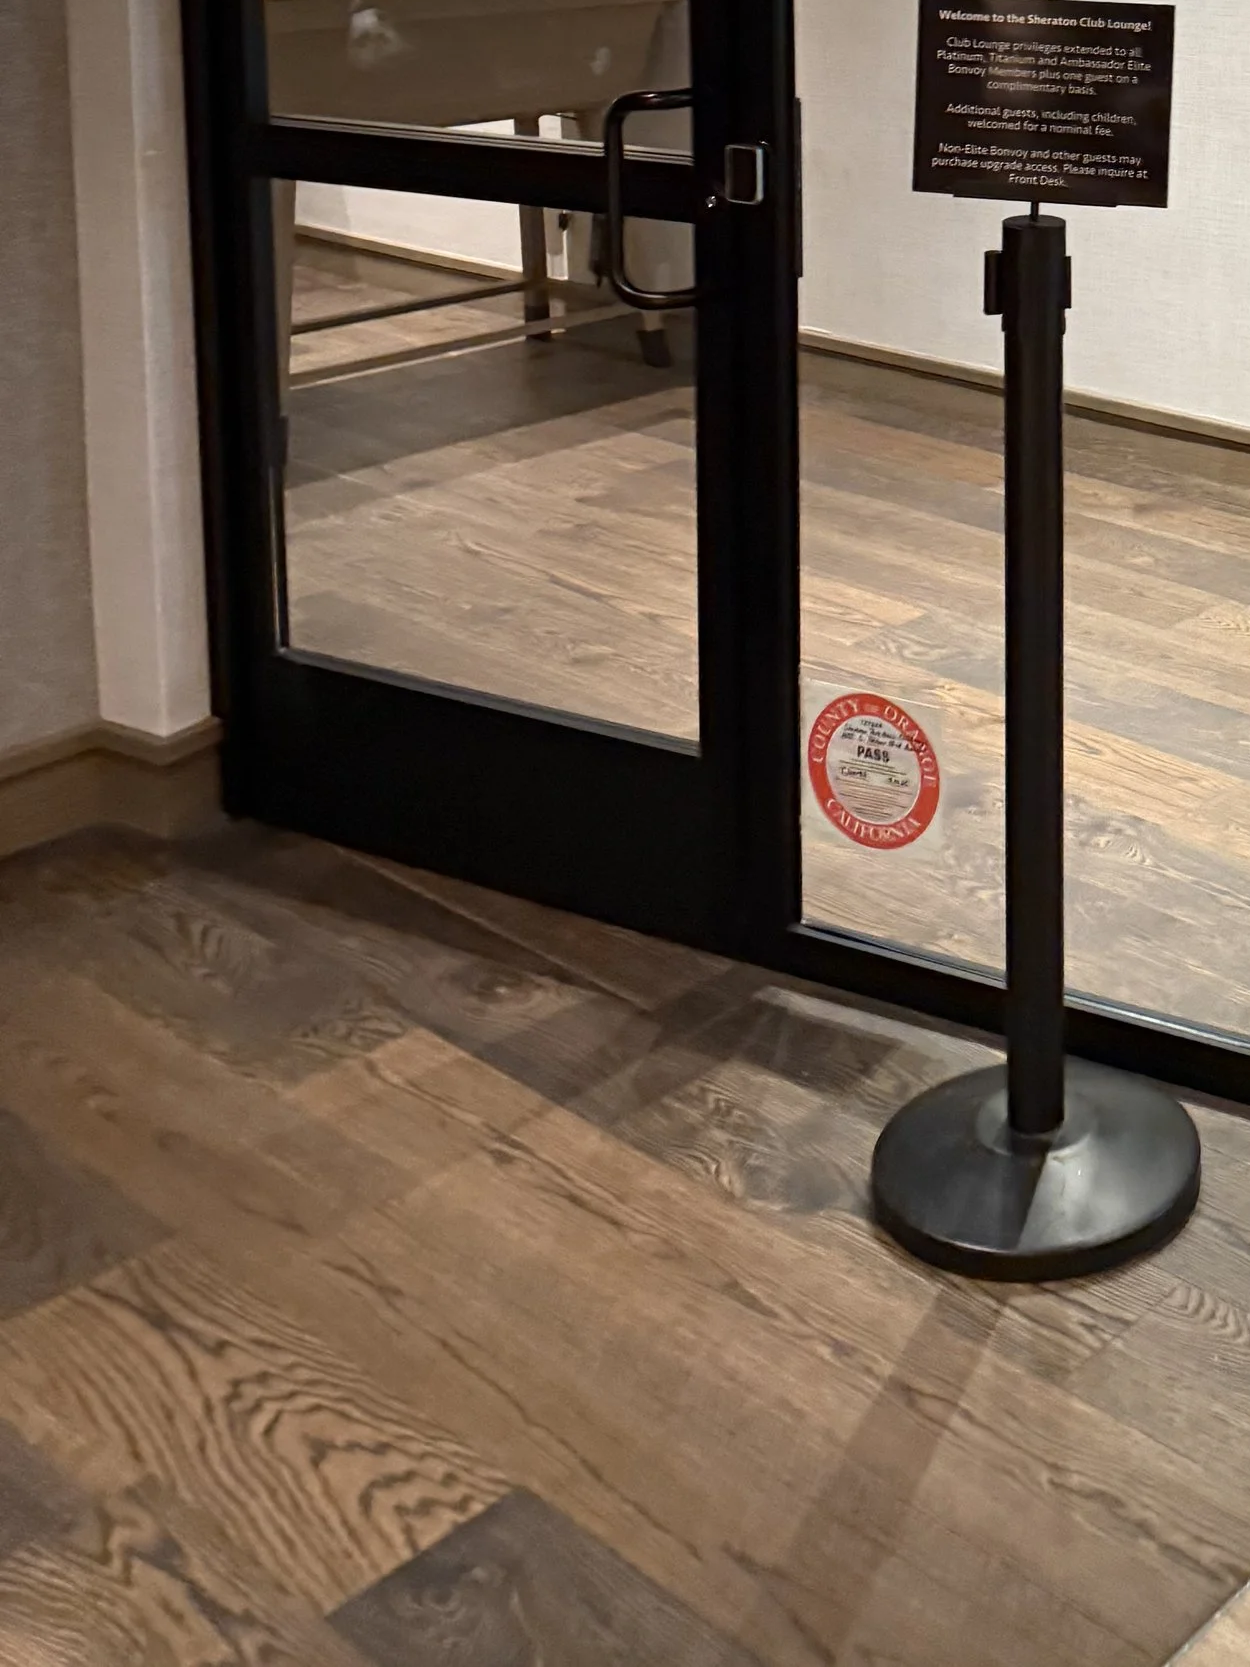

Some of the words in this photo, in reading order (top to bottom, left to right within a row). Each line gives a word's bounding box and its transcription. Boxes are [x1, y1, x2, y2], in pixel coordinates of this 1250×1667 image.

[939, 10, 990, 22] Welcome
[992, 14, 1005, 23] to
[1007, 14, 1026, 24] the
[1027, 15, 1077, 27] Sheraton
[1079, 17, 1105, 28] Club
[1107, 19, 1152, 33] Lounge!
[946, 36, 972, 48] Club
[973, 38, 1011, 52] Lounge
[1013, 41, 1062, 55] privileges
[1063, 45, 1113, 56] extended
[1114, 47, 1127, 56] to
[1128, 47, 1143, 57] all
[936, 50, 987, 63] Platinum,
[988, 53, 1036, 64] Titanium
[1038, 56, 1058, 66] and
[1060, 57, 1126, 70] Ambassador
[1128, 60, 1152, 72] Elite
[947, 64, 987, 77] Bonvoy
[988, 67, 1037, 79] Members
[1039, 69, 1061, 81] plus
[1062, 72, 1083, 81] one
[1084, 73, 1114, 84] guest
[1115, 75, 1130, 84] on
[1131, 76, 1139, 85] a
[986, 81, 1067, 96] complimentary
[1068, 84, 1098, 96] basis.
[945, 103, 1001, 116] Additional
[1002, 108, 1040, 120] guests,
[1041, 110, 1090, 124] including
[967, 119, 1021, 130] welcomed
[1023, 120, 1039, 132] for
[1040, 123, 1048, 132] a
[1049, 124, 1093, 135] nominal
[1094, 125, 1115, 137] fee.
[938, 142, 989, 156] Non-Elite
[990, 145, 1029, 160] Bonvoy
[1030, 149, 1051, 159] and
[1051, 150, 1081, 161] other
[1082, 153, 1117, 164] guests
[1118, 155, 1142, 167] may
[931, 156, 979, 168] purchase
[980, 159, 1023, 172] upgrade
[1025, 163, 1060, 174] access.
[1063, 163, 1097, 176] Please
[1097, 168, 1135, 179] inquire
[1135, 169, 1150, 180] at
[1008, 173, 1039, 185] Front
[1039, 175, 1069, 188] Desk.
[812, 698, 860, 764] COUNTY
[857, 745, 891, 763] PASS
[826, 798, 922, 841] CALIFORNIA
